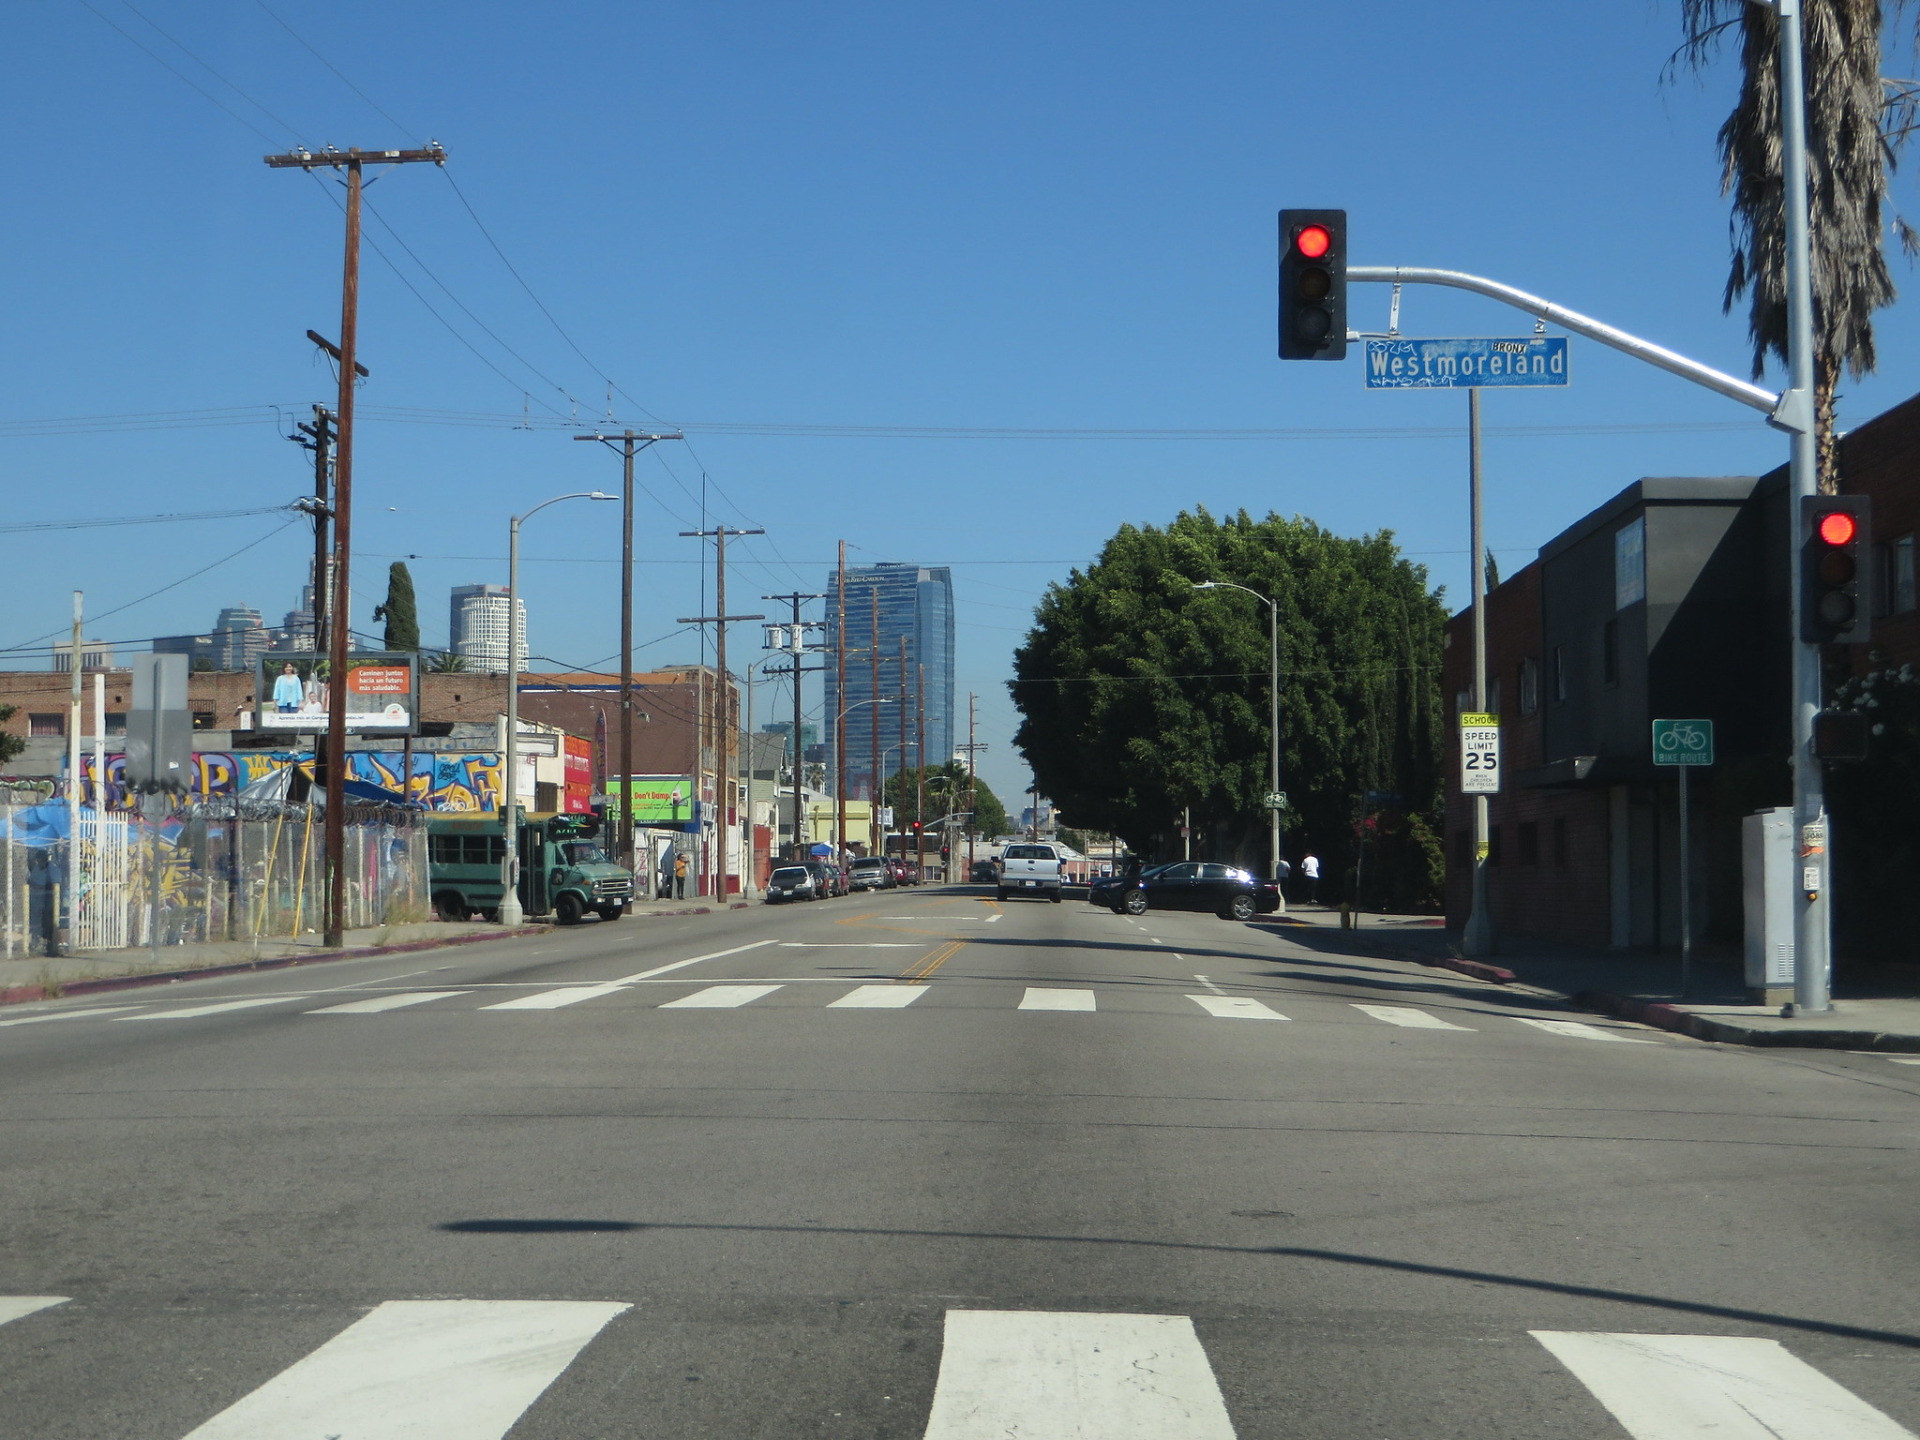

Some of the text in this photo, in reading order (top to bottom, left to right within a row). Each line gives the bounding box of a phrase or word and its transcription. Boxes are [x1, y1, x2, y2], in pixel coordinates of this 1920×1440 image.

[1492, 341, 1526, 354] BRONX
[1370, 348, 1563, 376] Westmoreland
[1463, 716, 1498, 725] SCHOOL
[1464, 732, 1497, 741] SPEED
[1467, 742, 1494, 750] LIMIT
[1465, 752, 1497, 770] 25
[1658, 753, 1707, 762] BIKE ROUTE
[634, 791, 650, 799] Don't
